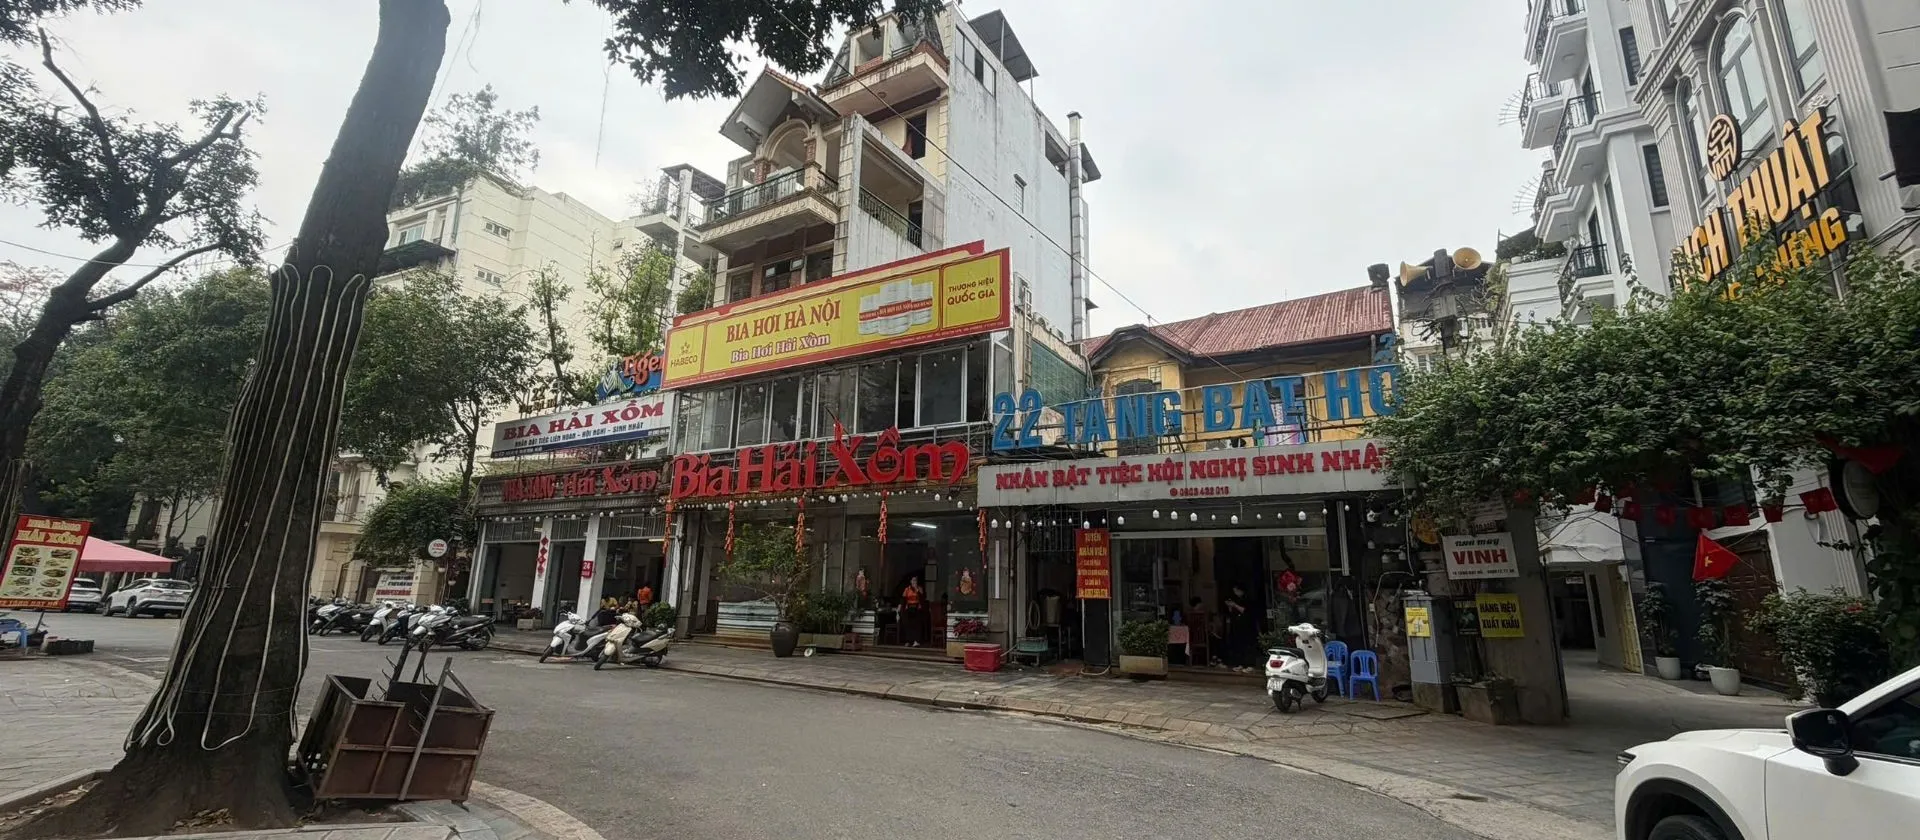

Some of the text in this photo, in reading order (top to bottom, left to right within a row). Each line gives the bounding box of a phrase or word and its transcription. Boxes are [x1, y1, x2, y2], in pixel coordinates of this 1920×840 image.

[1727, 109, 1830, 252] THUẬT
[949, 276, 994, 292] THƯƠNG HIỆU
[947, 291, 976, 305] QUỐC
[978, 288, 995, 300] GIA
[726, 322, 749, 343] BIA
[752, 314, 781, 337] HƠI
[784, 304, 806, 330] HÀ
[810, 298, 841, 327] NỘI
[670, 354, 698, 368] HABECO
[731, 348, 749, 363] Bia
[751, 342, 773, 359] Hơi
[992, 388, 1043, 452] 22
[1062, 386, 1182, 444] TĂNG
[1202, 376, 1306, 441] BẠT
[503, 423, 540, 440] BIA
[548, 411, 594, 434] HẢI
[671, 451, 733, 499] Bia
[732, 440, 818, 494] Hải
[996, 467, 1048, 493] NHẬN
[1052, 464, 1091, 490] ĐẶT
[1096, 460, 1143, 488] TIỆC
[1147, 457, 1184, 486] HỘI
[1189, 456, 1247, 482] NGHỊ
[1252, 452, 1315, 476] SINH
[1452, 549, 1508, 565] VINH
[1480, 601, 1499, 613] HÀNG
[1482, 616, 1500, 628] XUẤT
